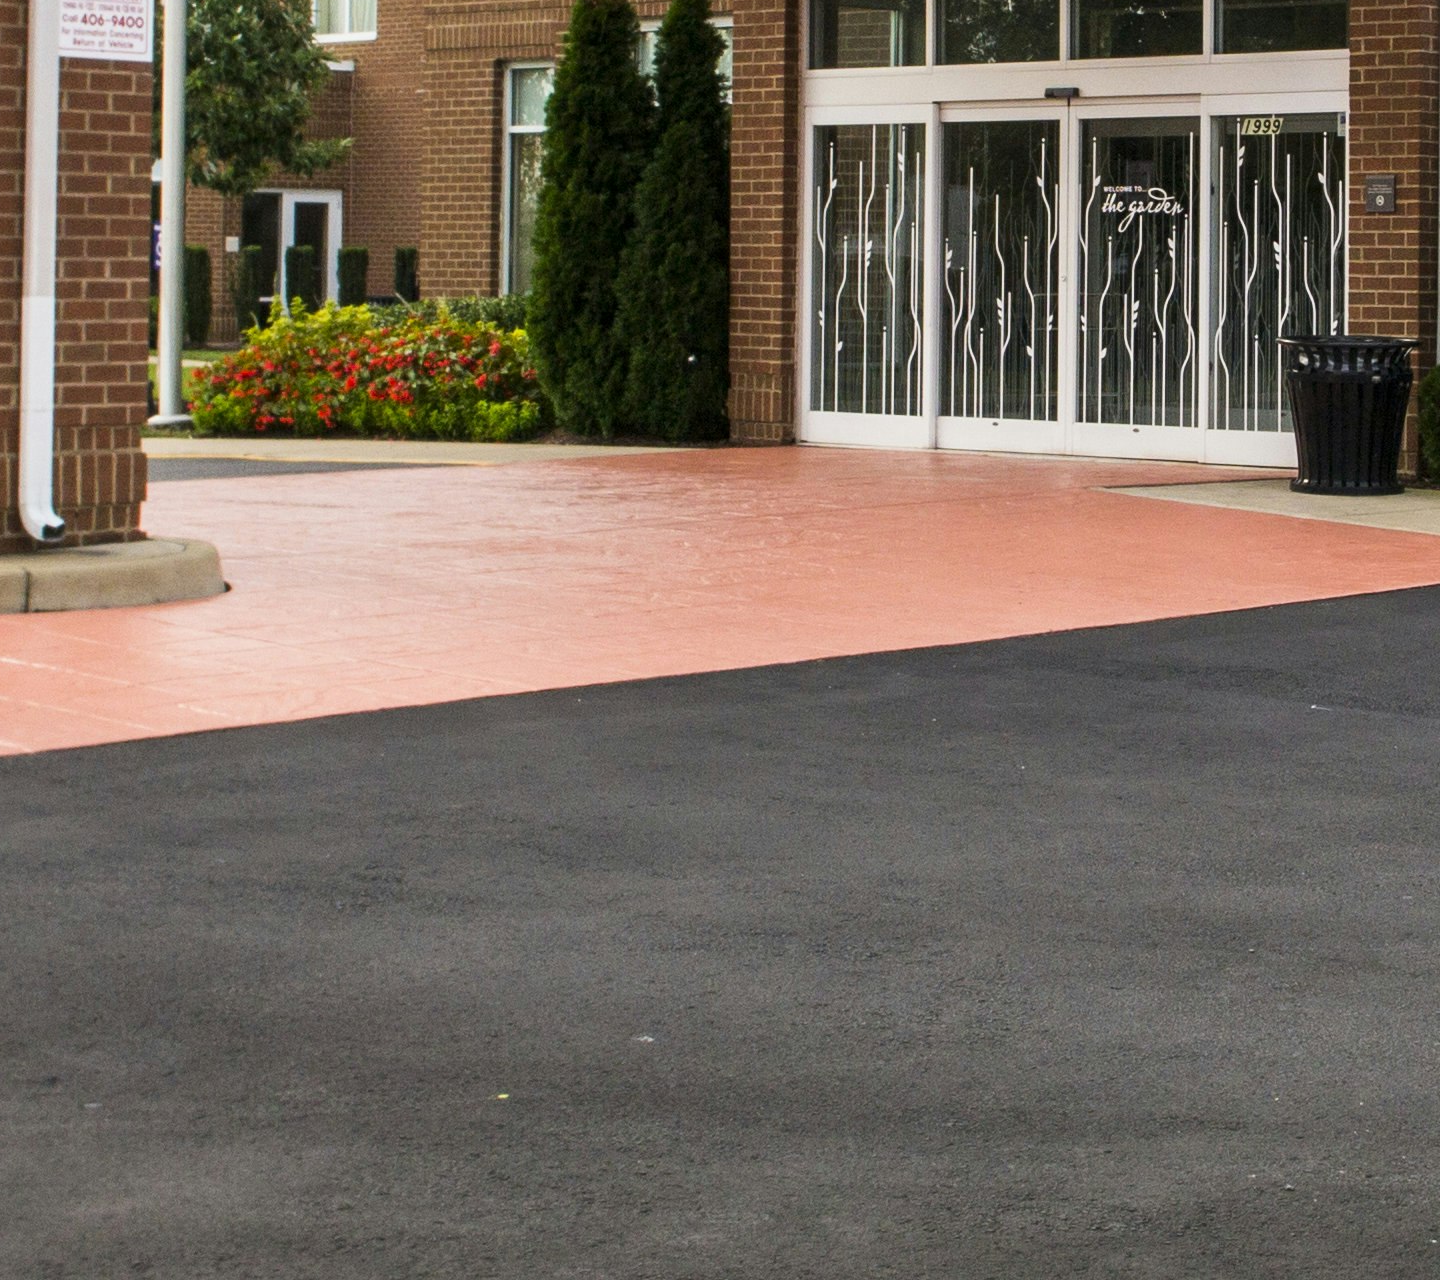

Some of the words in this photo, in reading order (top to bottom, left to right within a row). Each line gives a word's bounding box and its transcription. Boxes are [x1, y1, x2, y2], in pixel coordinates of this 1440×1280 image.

[62, 14, 78, 23] Call
[80, 13, 144, 29] 406-9400
[109, 40, 134, 49] Vehicle
[1244, 118, 1282, 134] 1999
[1102, 193, 1126, 213] the
[1118, 187, 1184, 233] garden
